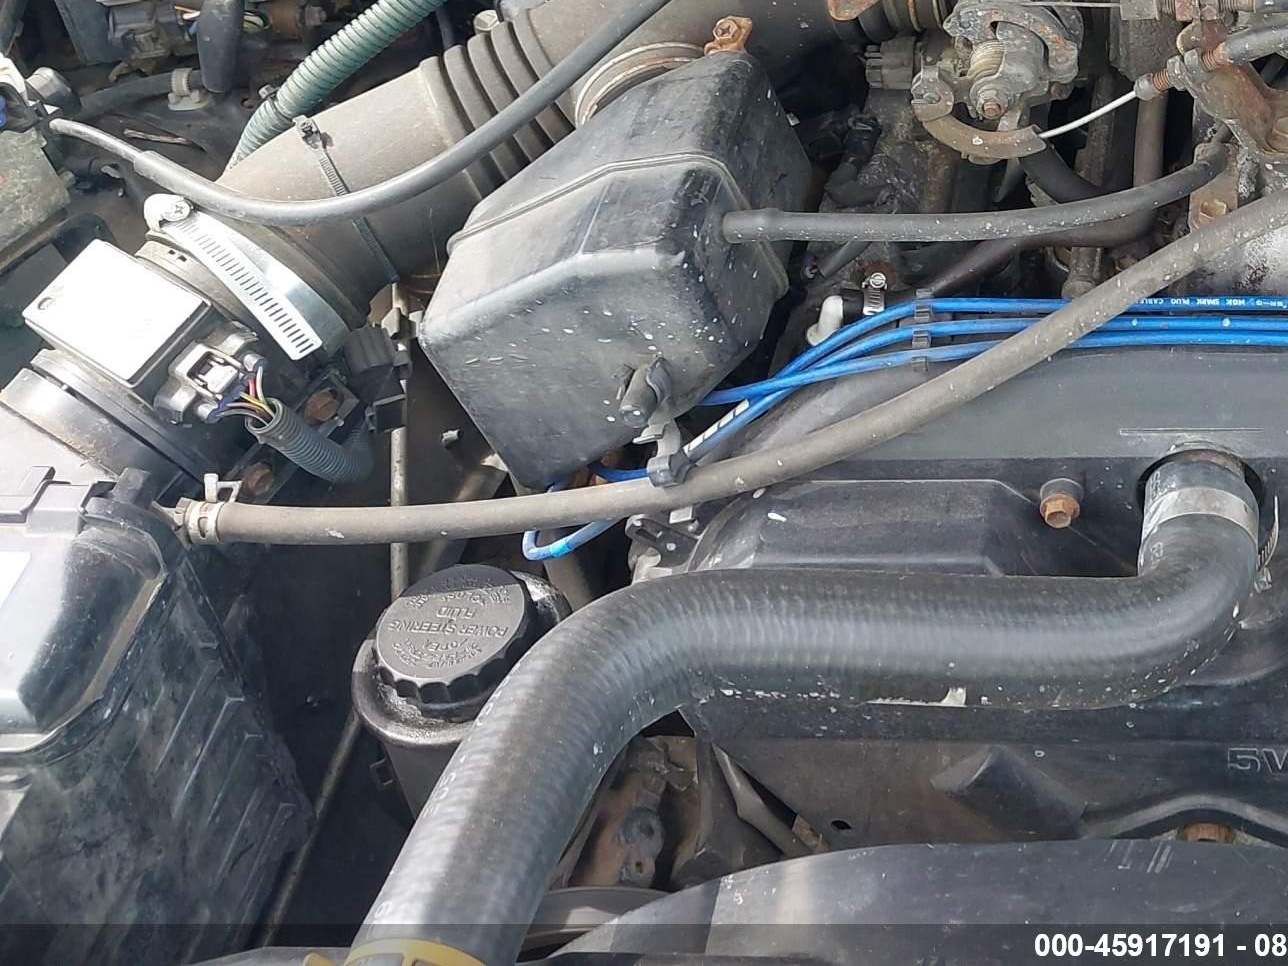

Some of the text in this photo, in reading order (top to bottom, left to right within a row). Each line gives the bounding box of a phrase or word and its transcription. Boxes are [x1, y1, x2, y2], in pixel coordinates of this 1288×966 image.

[1170, 297, 1190, 305] PLUG
[1196, 297, 1220, 306] SPARK
[436, 605, 477, 619] FLUID
[387, 619, 508, 639] POWER STEERING
